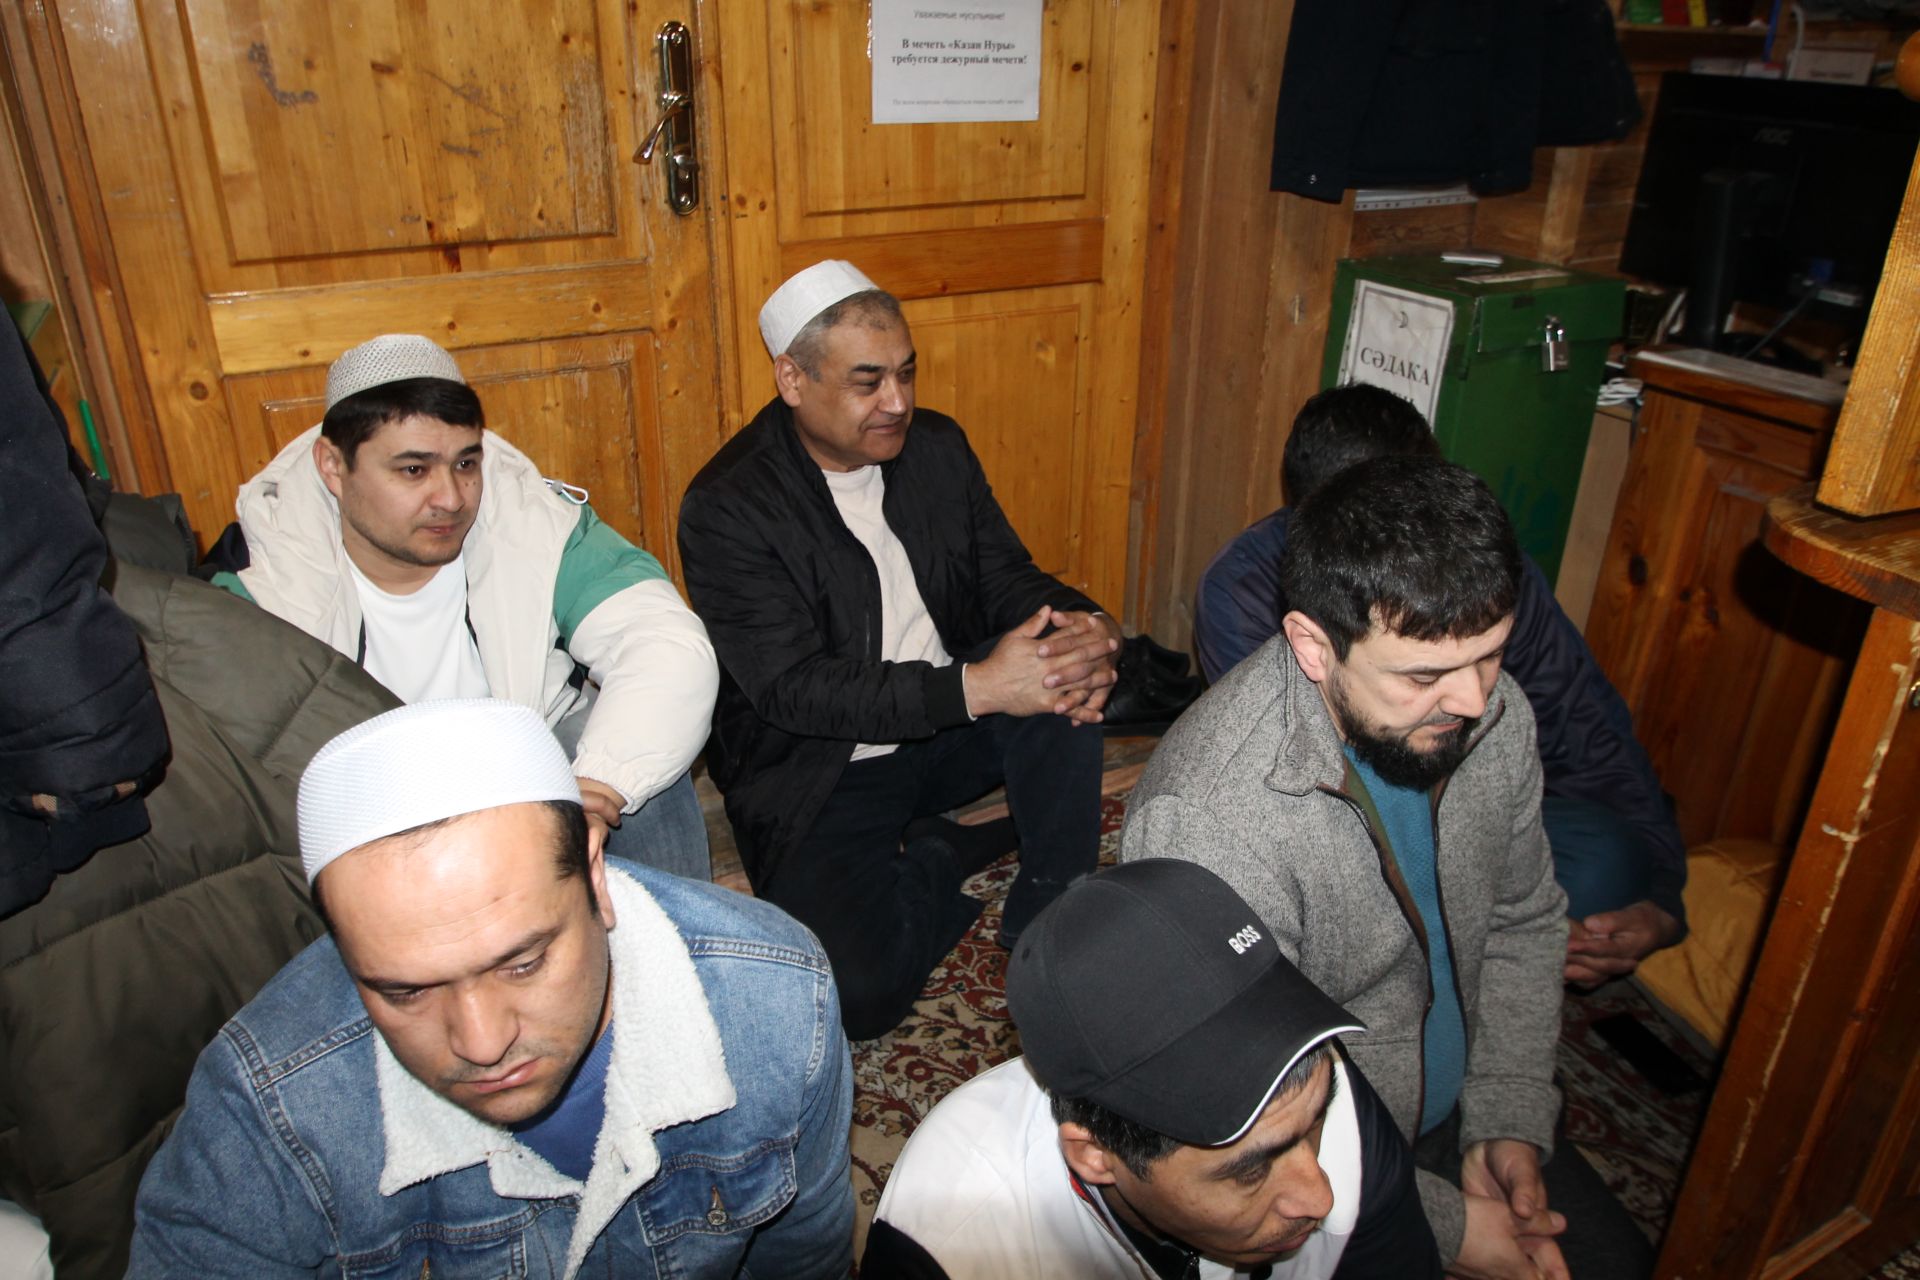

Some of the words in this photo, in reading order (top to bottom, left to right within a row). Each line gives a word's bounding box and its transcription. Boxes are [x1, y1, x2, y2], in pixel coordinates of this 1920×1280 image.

[902, 39, 909, 48] В
[948, 40, 981, 49] «Казан
[984, 40, 1015, 52] Нуры»
[892, 54, 938, 65] требуется
[940, 54, 989, 65] дежурный
[1360, 346, 1429, 386] СӘДАКА
[1228, 924, 1262, 954] BOSS
